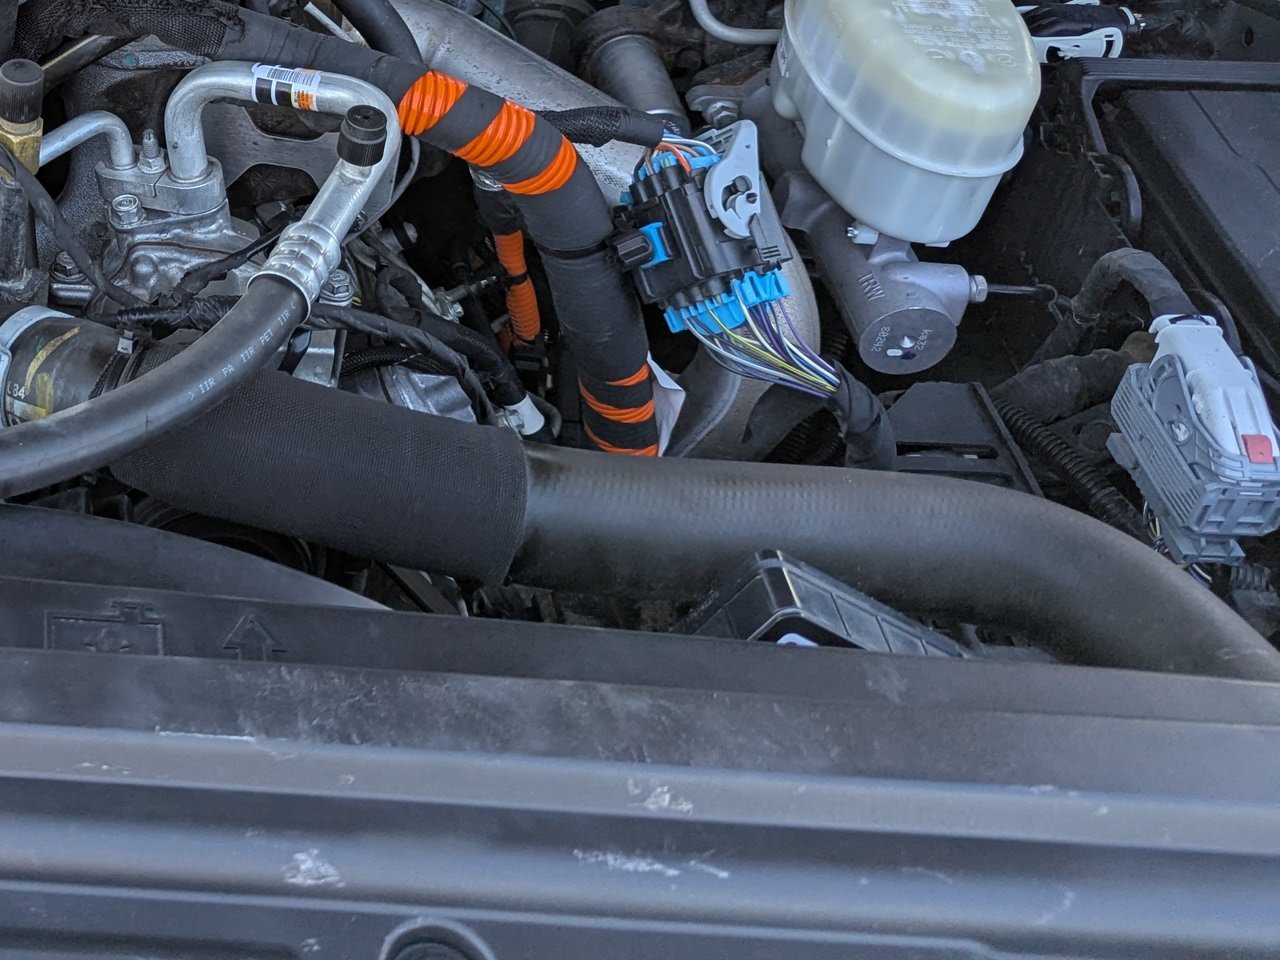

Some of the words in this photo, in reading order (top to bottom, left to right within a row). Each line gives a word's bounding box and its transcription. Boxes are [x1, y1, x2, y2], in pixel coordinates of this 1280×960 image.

[858, 273, 886, 301] TRW
[222, 364, 235, 377] PA
[260, 328, 274, 345] PET
